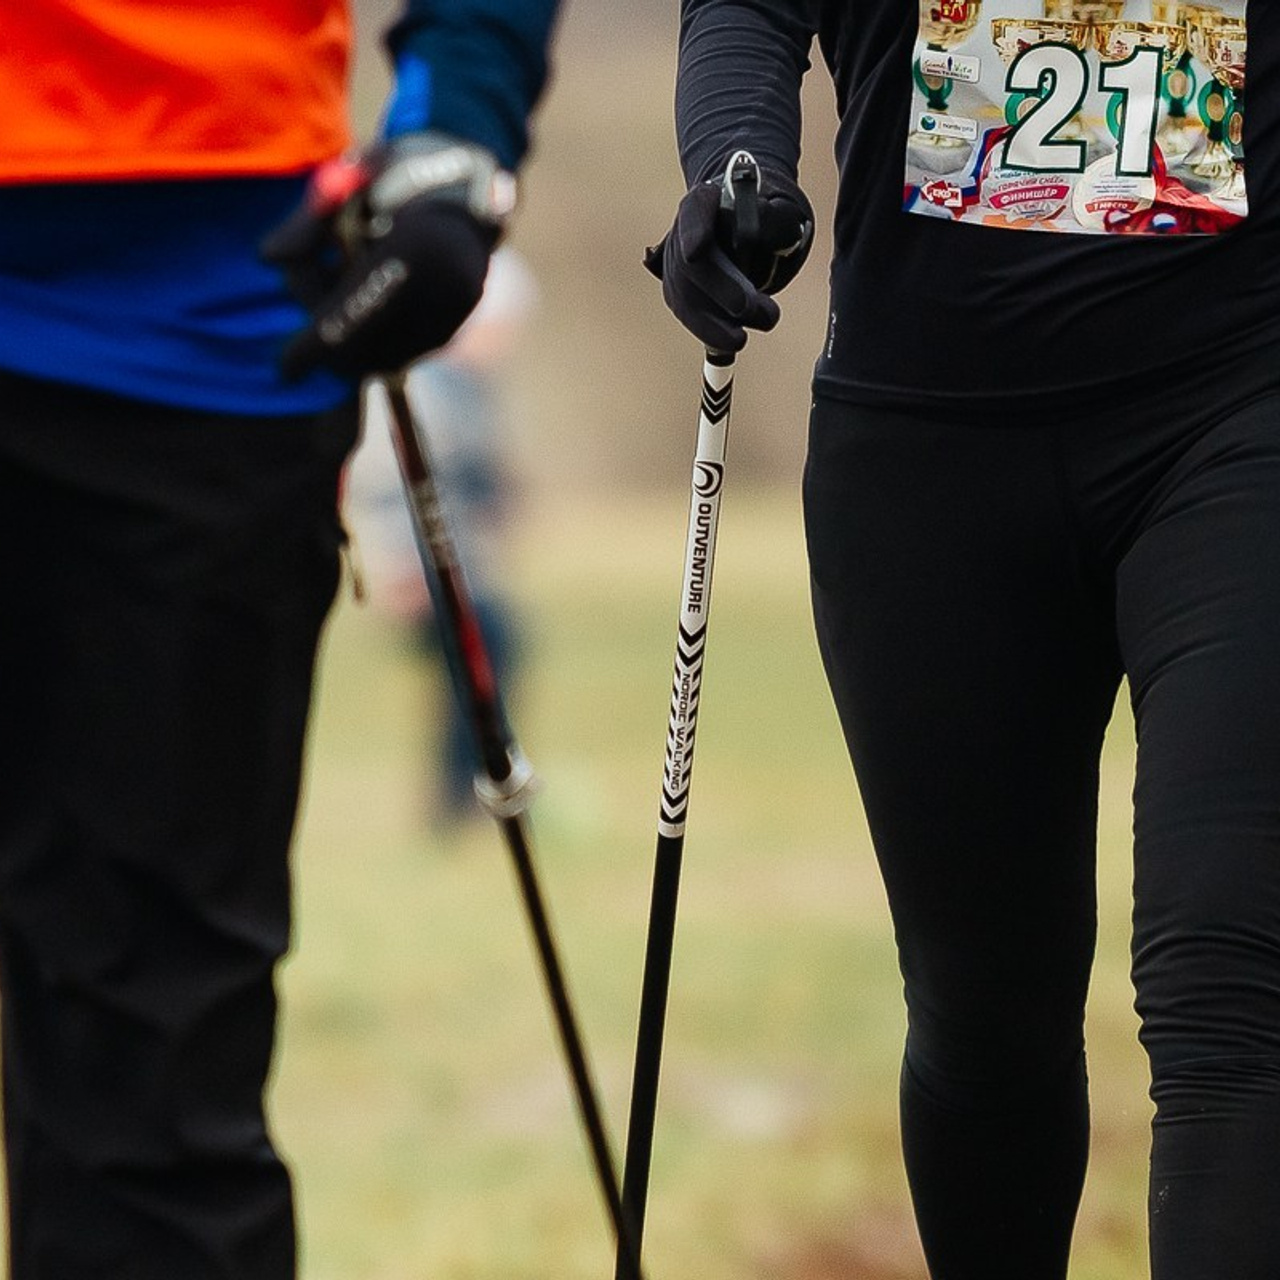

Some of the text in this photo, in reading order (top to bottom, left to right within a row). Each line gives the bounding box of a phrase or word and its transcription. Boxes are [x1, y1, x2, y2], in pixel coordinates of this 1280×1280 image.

[1002, 41, 1164, 176] 21
[687, 503, 712, 614] OUTVENTURE
[670, 673, 691, 791] NORDIC WALKING
